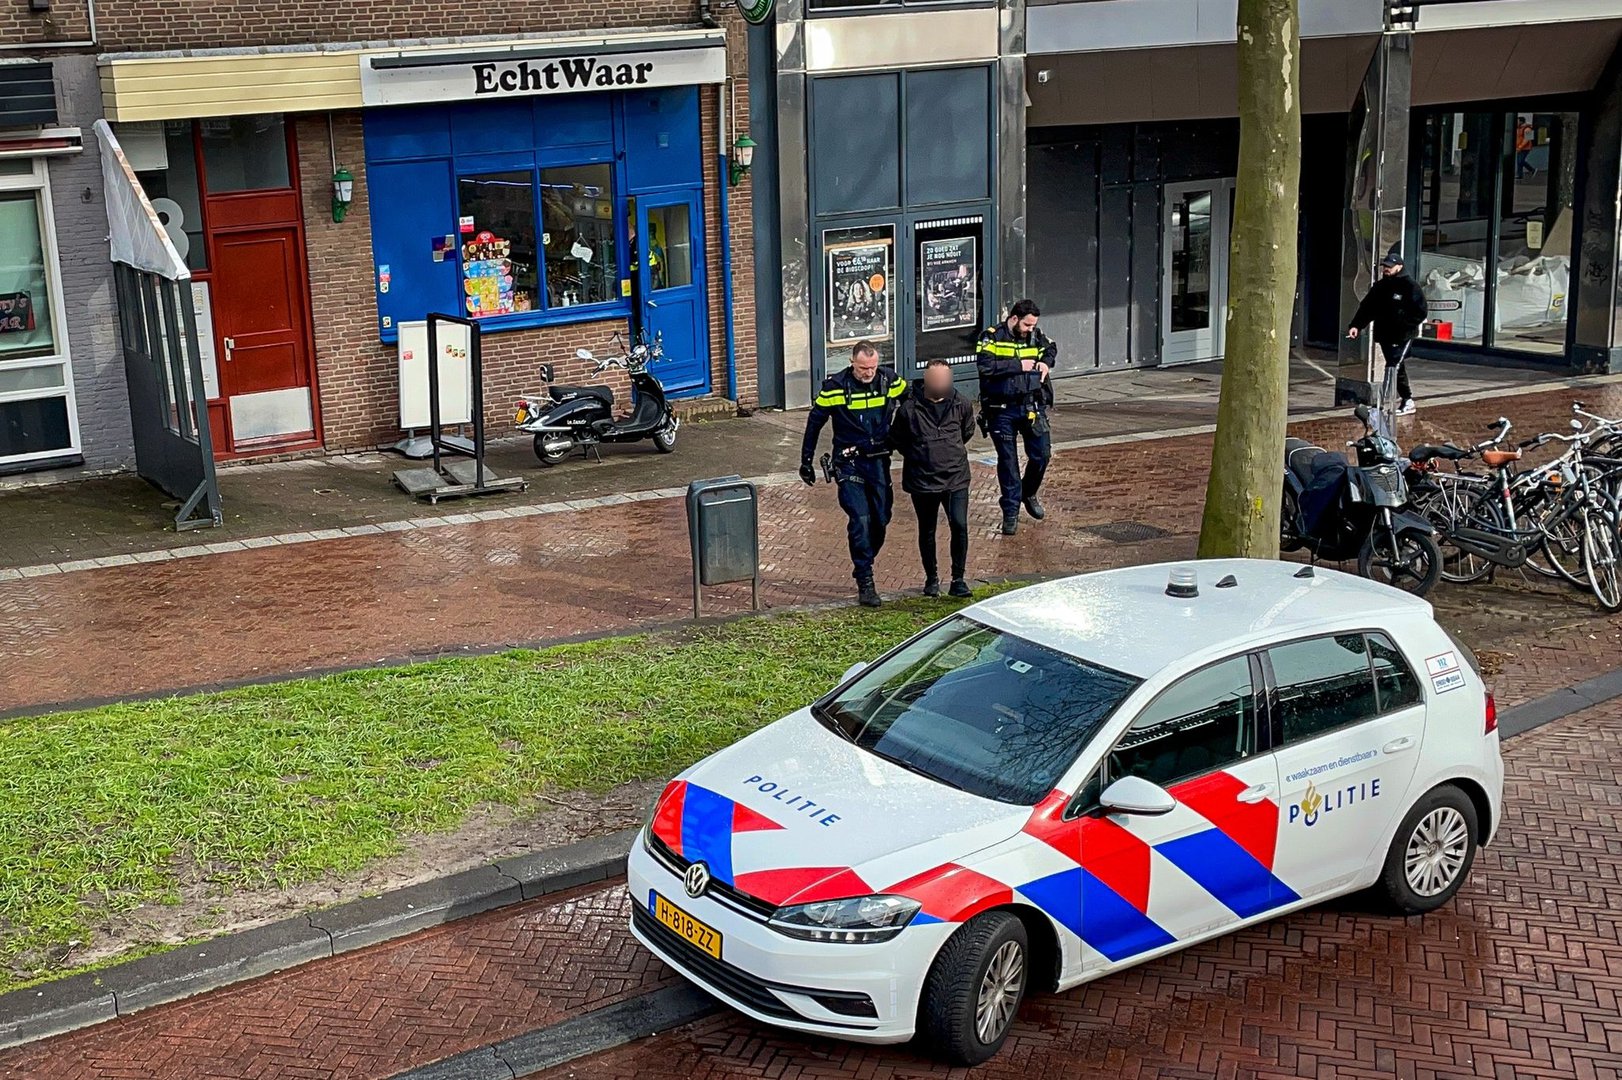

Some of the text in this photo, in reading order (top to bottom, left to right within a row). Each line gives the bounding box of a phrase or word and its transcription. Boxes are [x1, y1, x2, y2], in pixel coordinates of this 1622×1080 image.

[472, 57, 653, 95] EchtWaar
[1291, 763, 1328, 781] waakzaam
[1328, 760, 1338, 770] en
[1337, 750, 1373, 767] dienstbaar
[742, 775, 842, 827] POLITIE
[660, 901, 714, 953] H-818-ZZ
